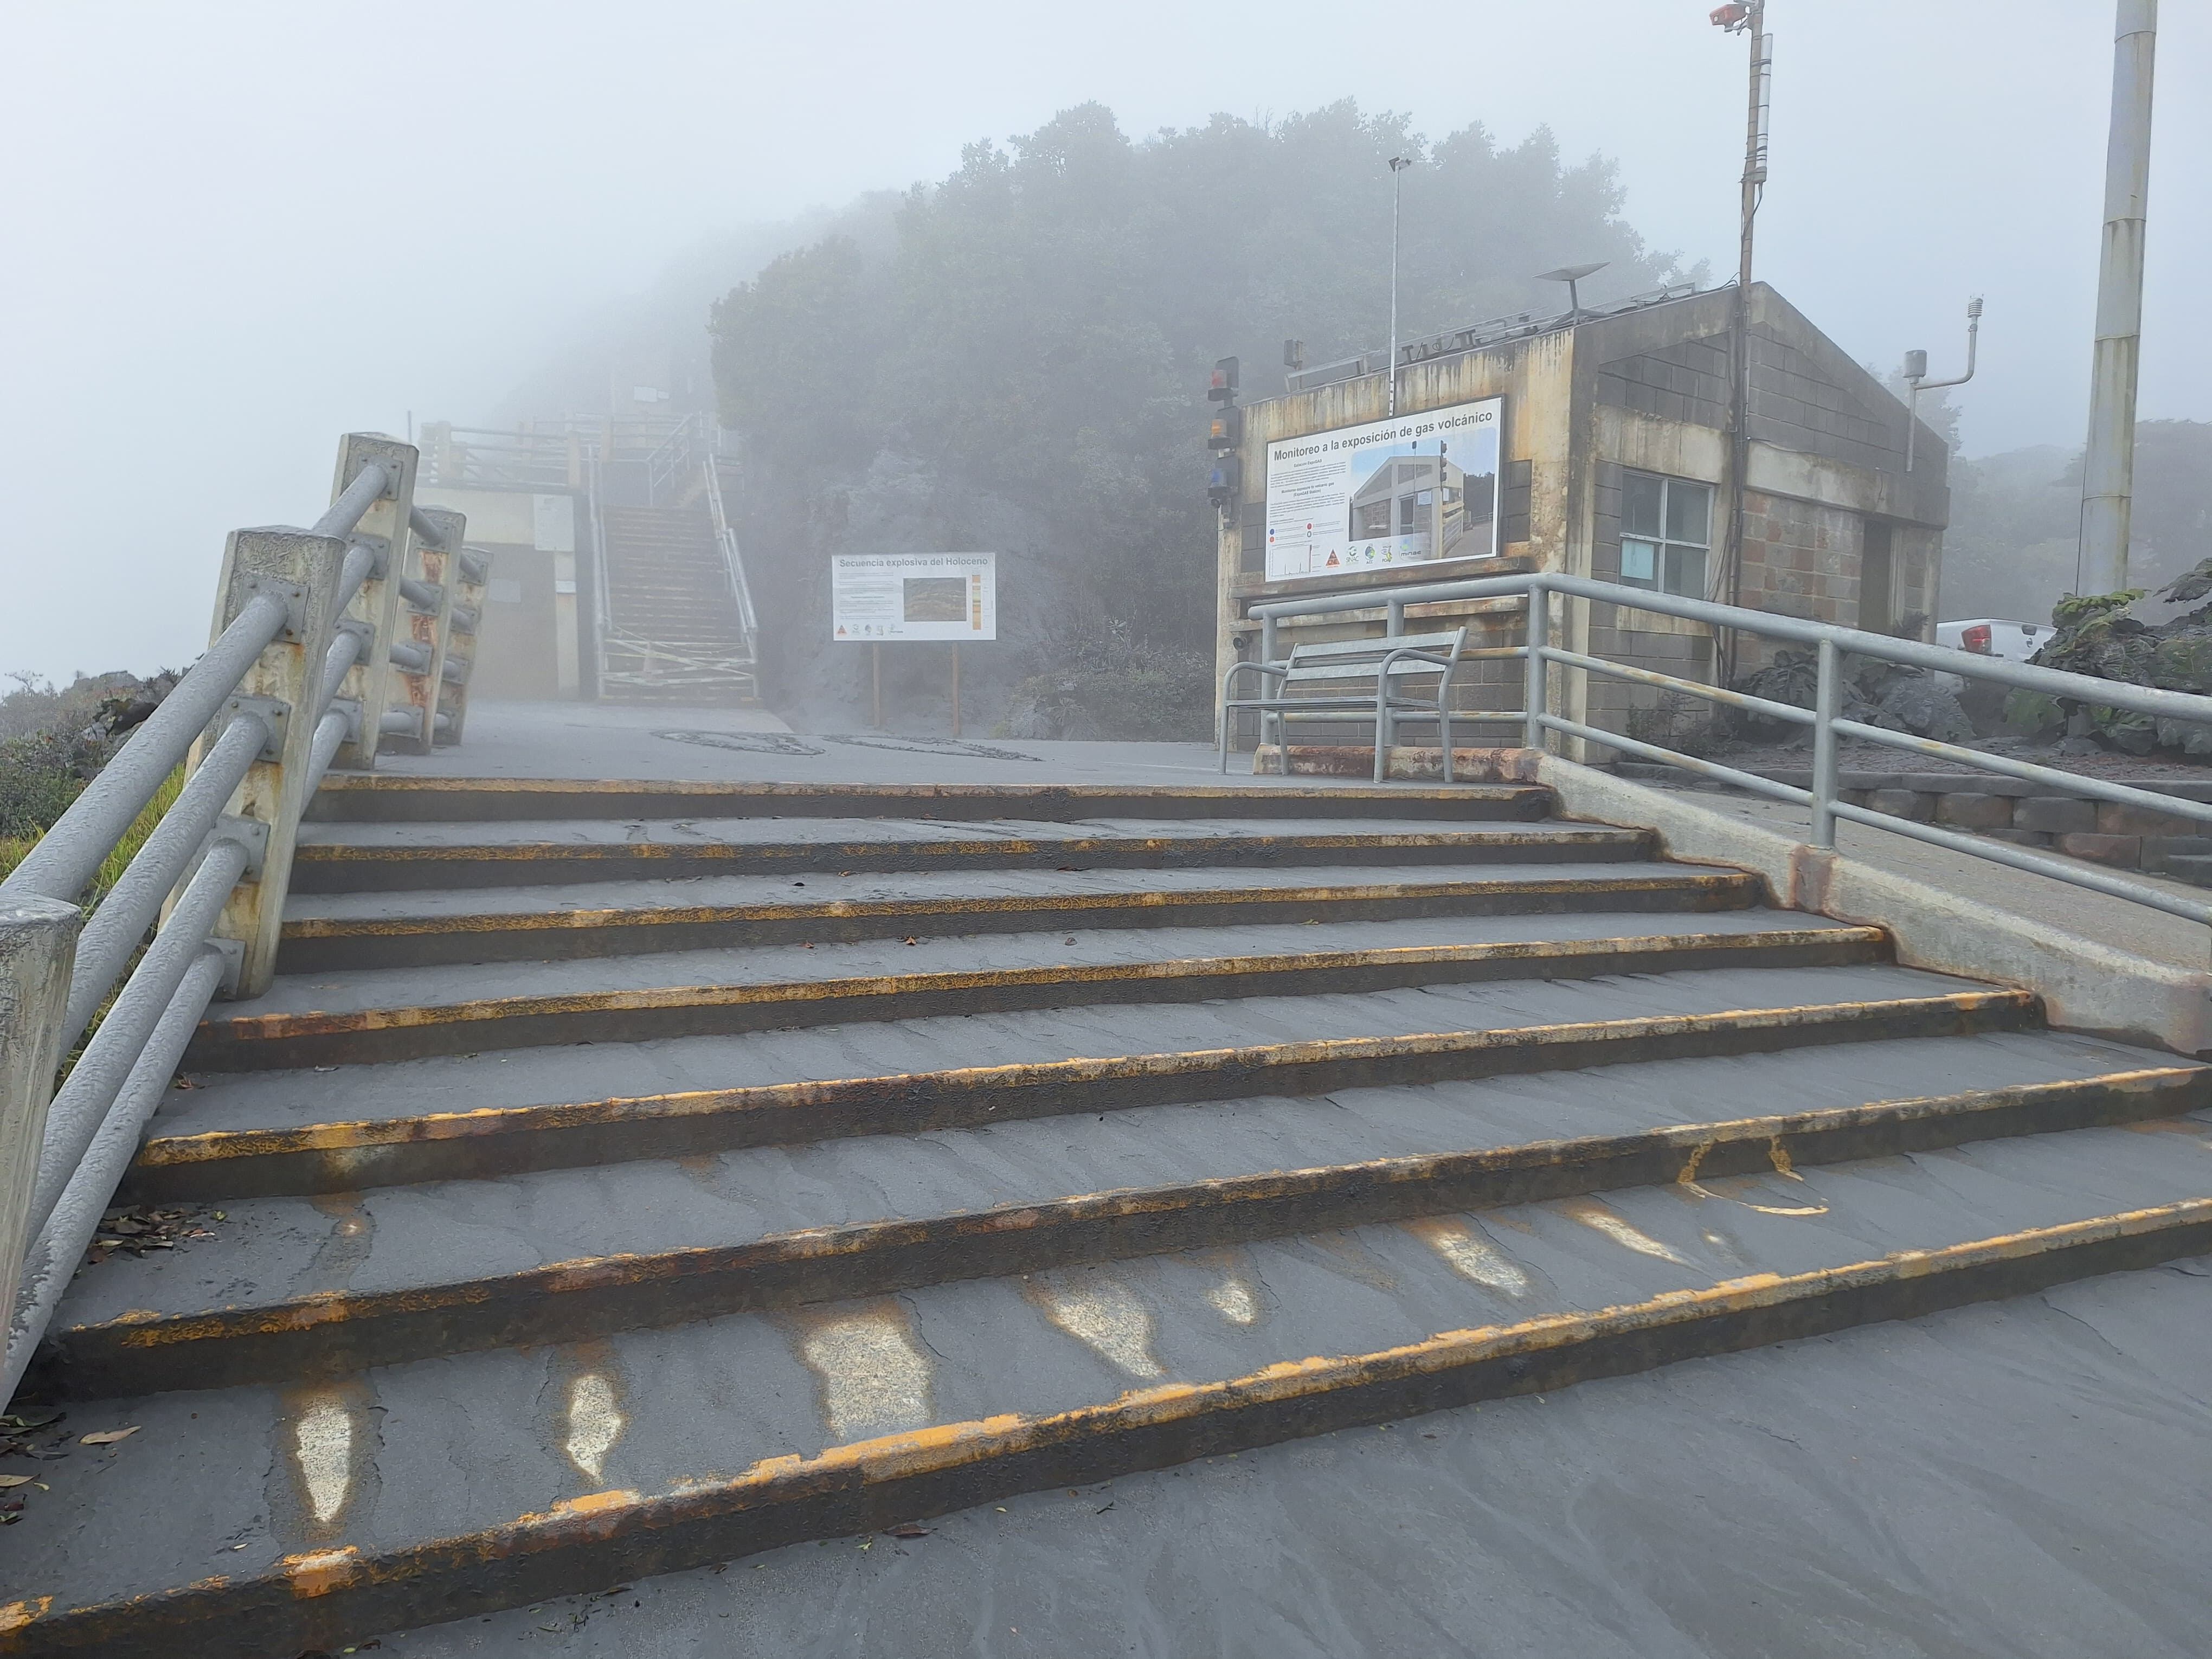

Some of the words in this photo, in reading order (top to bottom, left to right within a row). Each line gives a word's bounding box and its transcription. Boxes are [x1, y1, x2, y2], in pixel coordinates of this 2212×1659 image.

[1274, 445, 1320, 461] Monitoreo
[1322, 443, 1328, 452] a
[1331, 440, 1339, 450] la
[1342, 429, 1396, 449] exposición
[1400, 426, 1412, 437] de
[1416, 423, 1434, 437] gas
[1438, 411, 1492, 429] volcánico
[840, 559, 884, 567] Secuencia
[886, 558, 927, 568] explosiva
[946, 557, 988, 565] Holoceno
